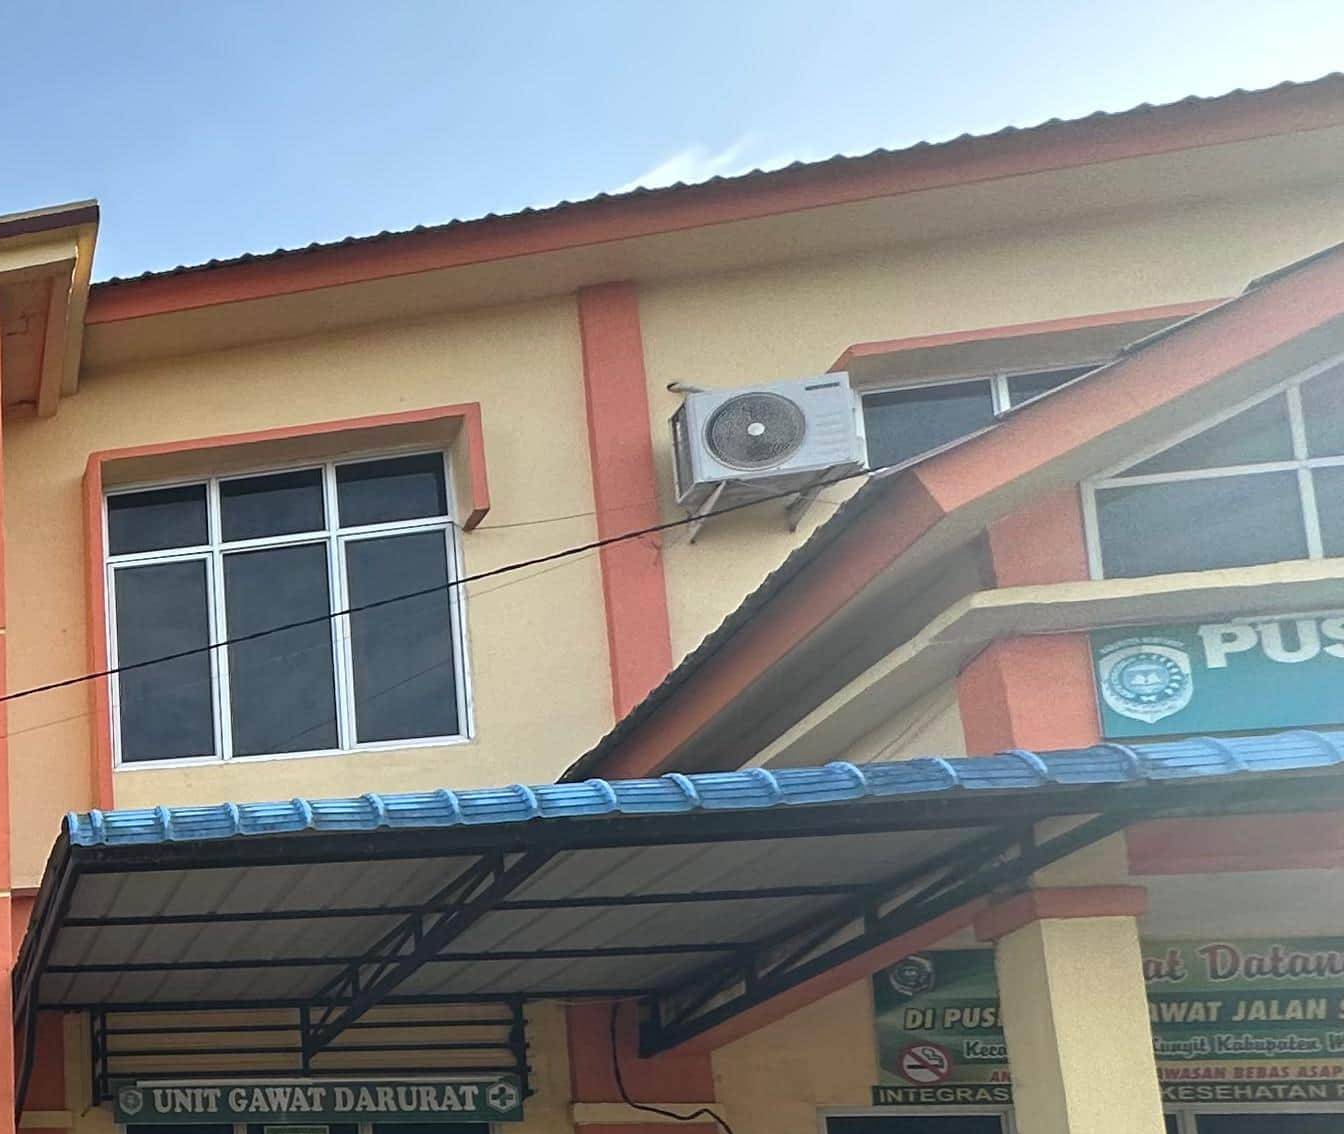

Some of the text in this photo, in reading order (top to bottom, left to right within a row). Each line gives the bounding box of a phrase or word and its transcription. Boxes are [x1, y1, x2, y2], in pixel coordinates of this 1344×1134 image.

[1142, 949, 1187, 982] at
[904, 1008, 936, 1031] DI
[943, 1008, 1002, 1029] PUS
[1232, 998, 1327, 1021] JALAN
[152, 1085, 478, 1113] UNIT GAWAT DARURAT
